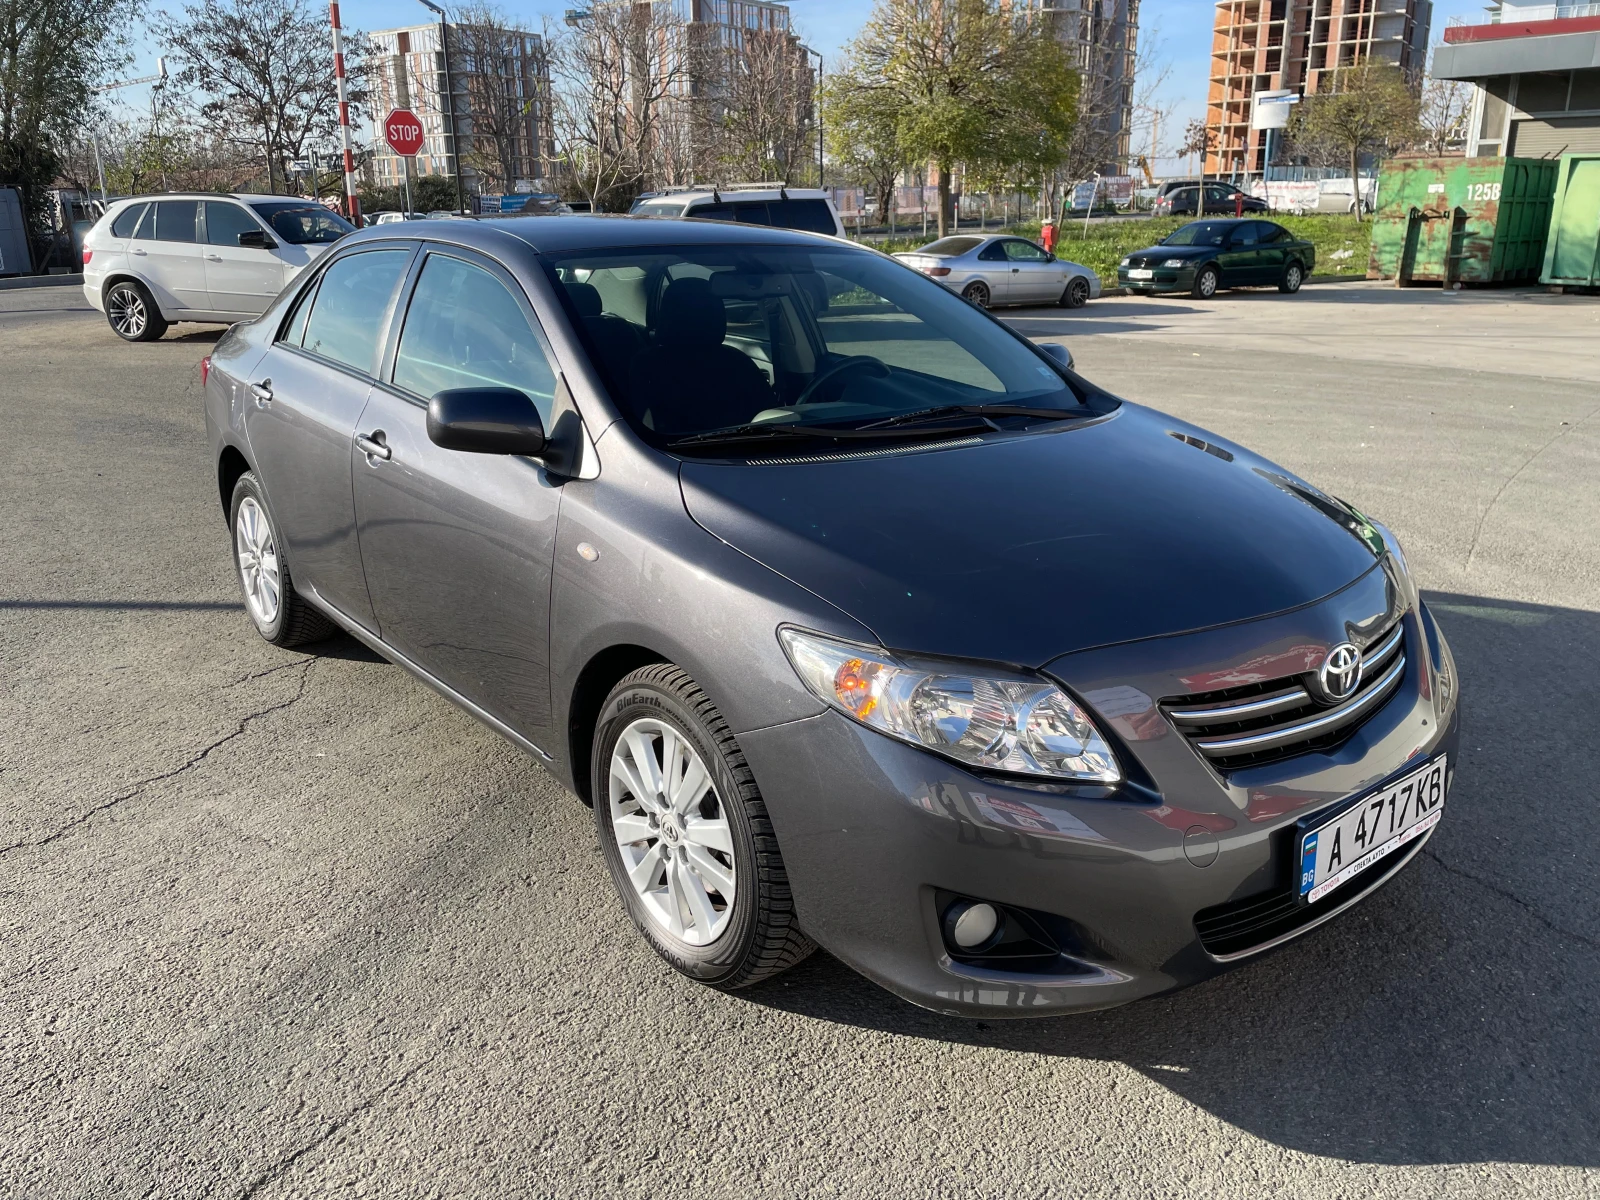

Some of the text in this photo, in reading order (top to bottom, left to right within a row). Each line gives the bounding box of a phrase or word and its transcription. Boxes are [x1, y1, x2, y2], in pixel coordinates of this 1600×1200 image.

[389, 124, 419, 141] STOP
[616, 693, 662, 713] BluEarth
[1327, 825, 1342, 873] A
[1302, 869, 1314, 886] BG
[1320, 876, 1340, 893] TOYOTA
[1353, 856, 1371, 873] СПЕКТА
[640, 922, 687, 970] YOKOHAMA
